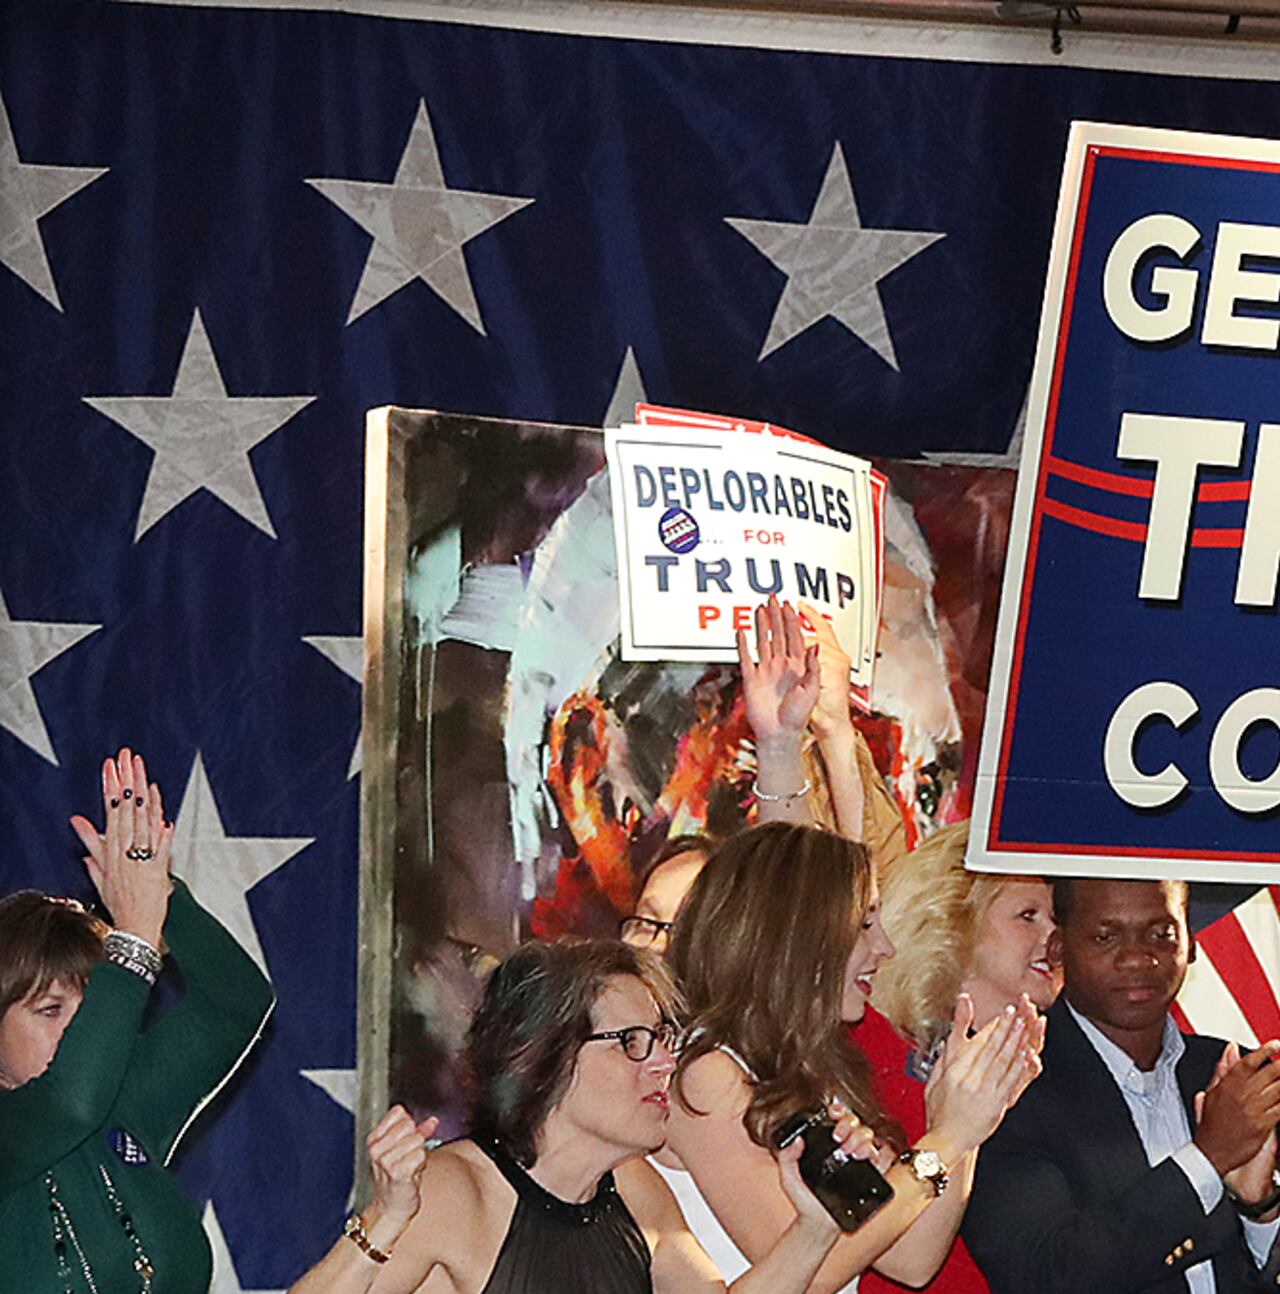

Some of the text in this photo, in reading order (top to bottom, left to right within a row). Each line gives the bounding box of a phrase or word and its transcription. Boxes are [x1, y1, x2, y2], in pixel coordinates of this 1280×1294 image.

[633, 465, 852, 533] DEPLORABLES
[744, 529, 785, 546] FOR
[645, 555, 856, 609] TRUMP
